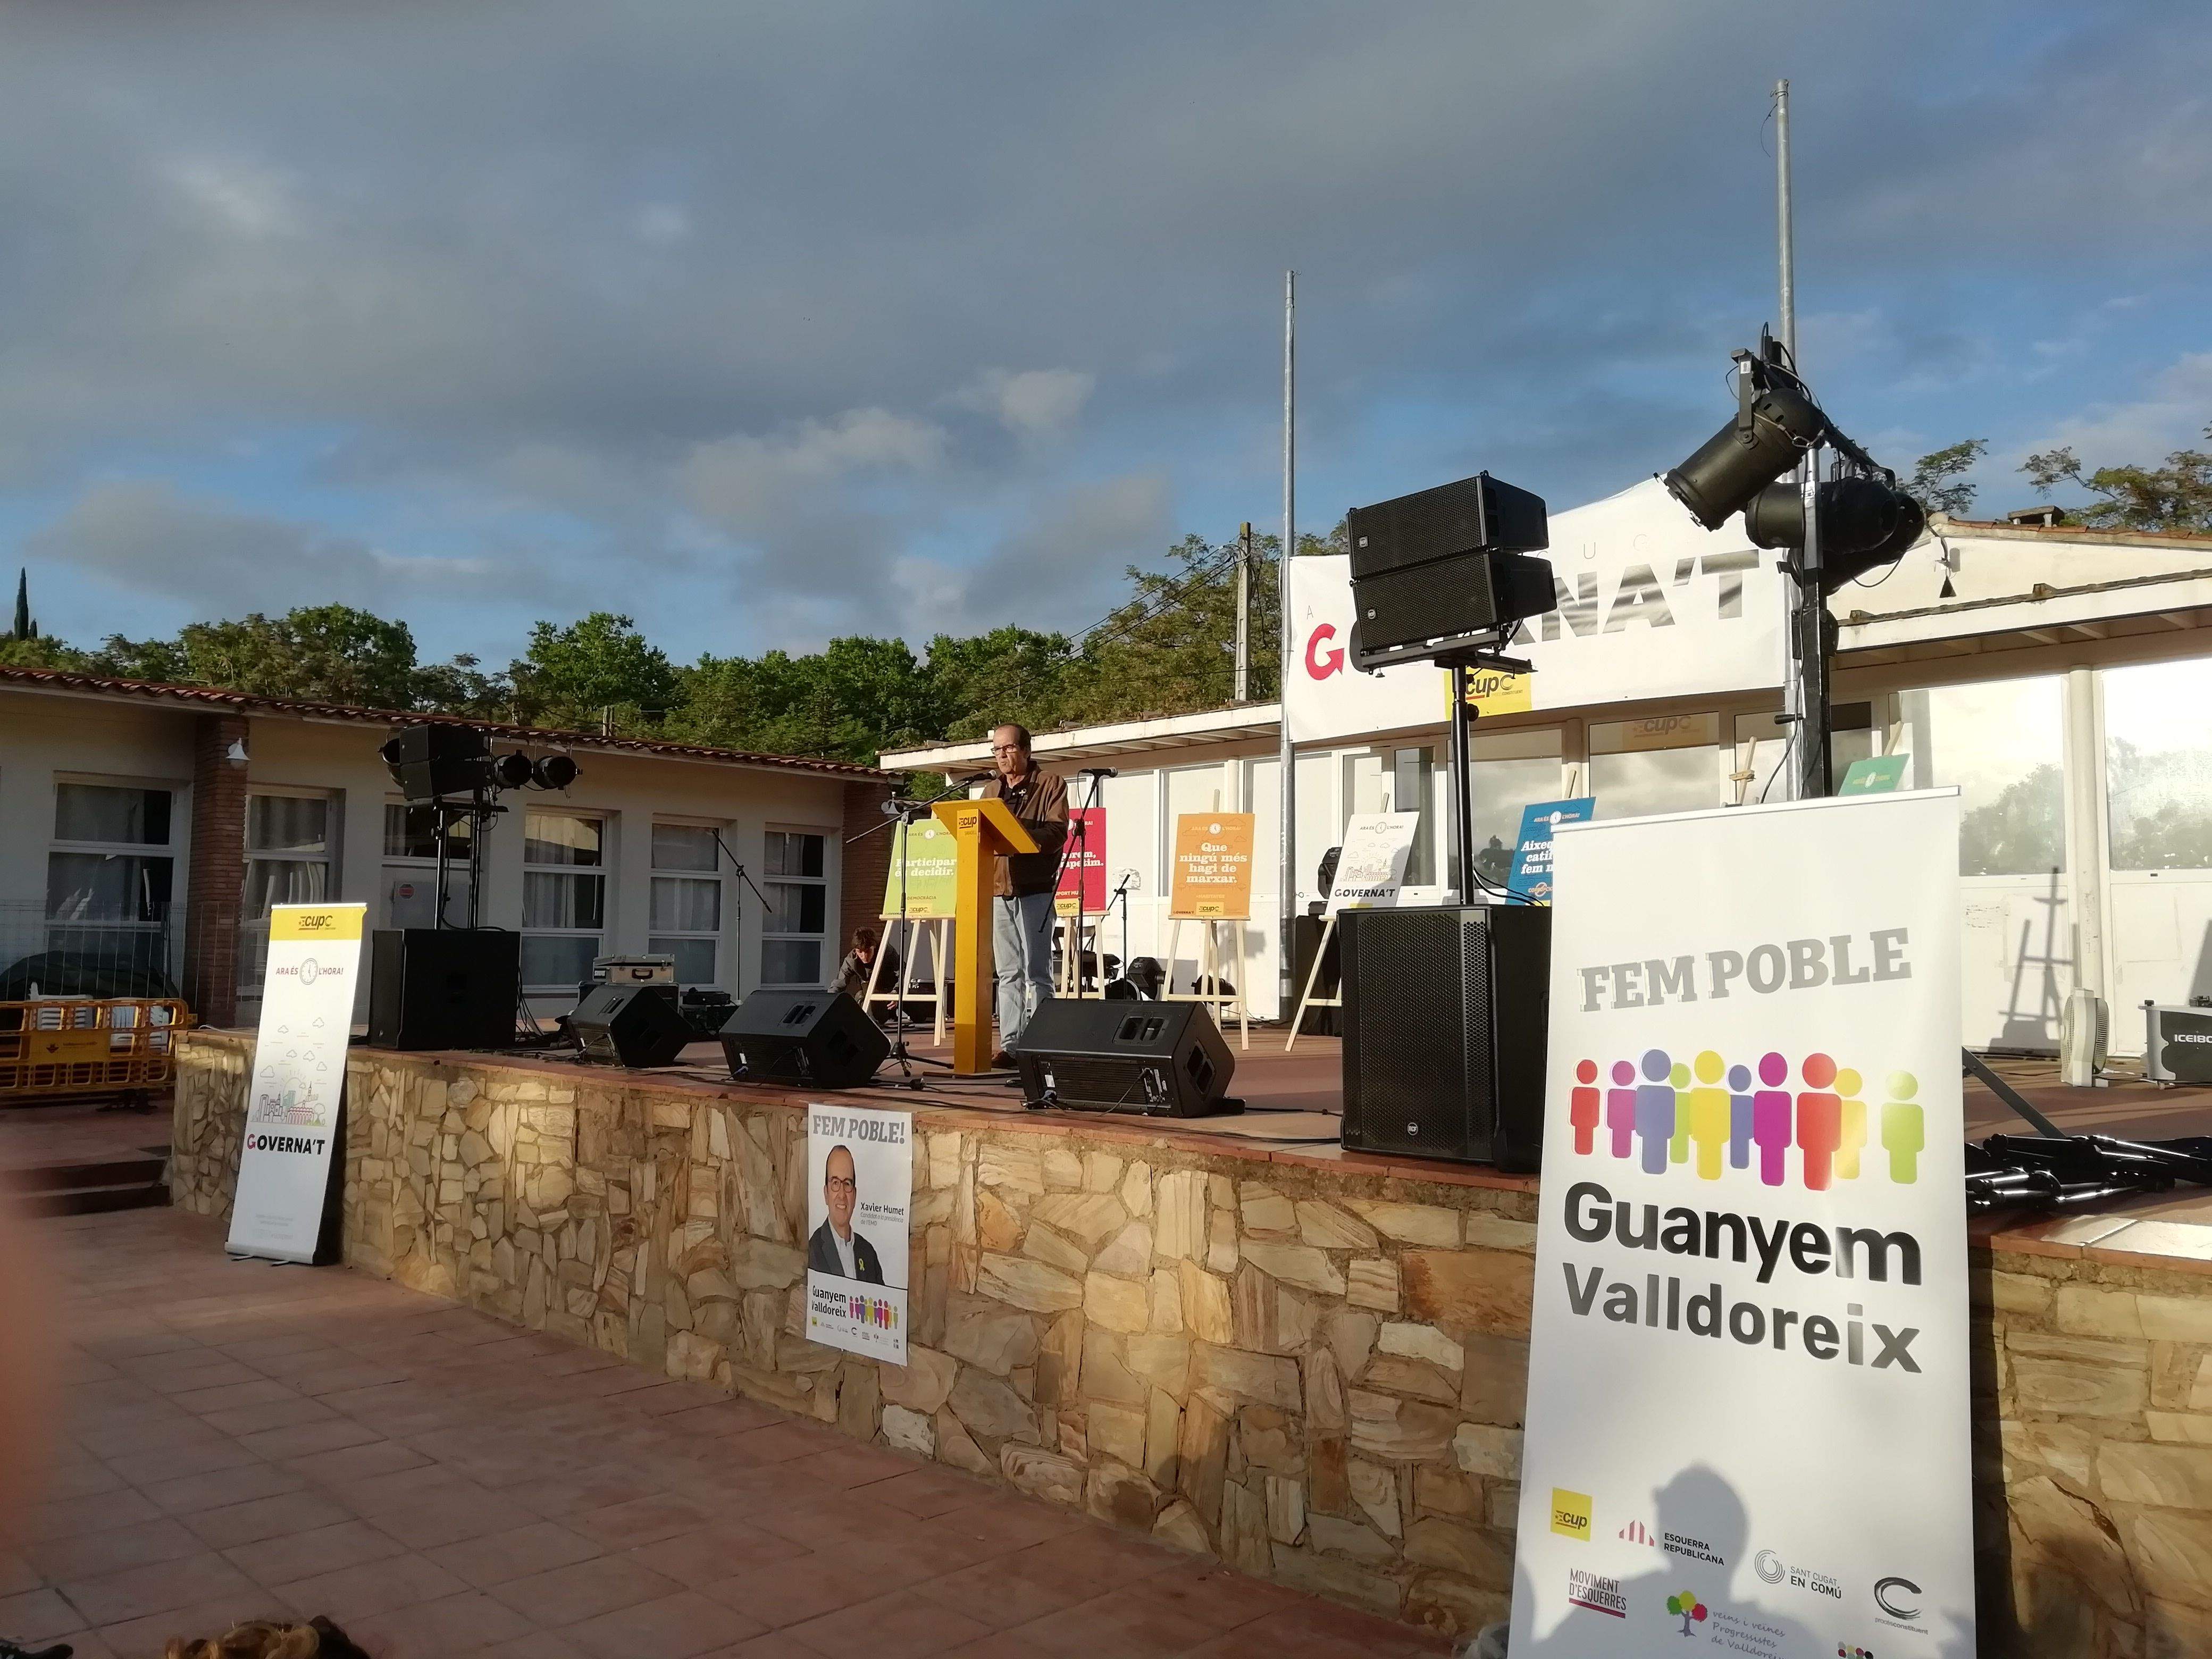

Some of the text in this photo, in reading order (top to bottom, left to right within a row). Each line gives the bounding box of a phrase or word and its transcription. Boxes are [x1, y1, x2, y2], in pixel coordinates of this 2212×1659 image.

[1201, 842, 1227, 852] Que
[1179, 852, 1247, 864] ningú més
[911, 868, 954, 877] decidir.
[1189, 864, 1237, 874] hagi de
[1521, 864, 1543, 874] fem
[1335, 889, 1395, 898] GOVERNA'T
[290, 966, 298, 975] ÉS
[1576, 927, 1913, 1012] FEM POBLE
[813, 1115, 905, 1144] FEM POBLE!
[247, 1134, 325, 1155] GOVERNA'T
[860, 1202, 904, 1216] Xavier Humet
[1564, 1182, 1923, 1286] Guanyem
[812, 1285, 846, 1303] Guanyem
[811, 1300, 847, 1318] Valldoreix
[1562, 1262, 1923, 1374] Valldoreix
[1664, 1532, 1710, 1552] ESQUERRA
[1664, 1543, 1725, 1566] REPUBLICANA
[1570, 1568, 1620, 1594] MOVIMENT
[1790, 1566, 1838, 1586] SANT CUGAT
[1569, 1582, 1627, 1611] D'ESQUERRES
[1790, 1576, 1842, 1599] EN COMÚ
[1713, 1622, 1778, 1648] Progressistes
[1711, 1636, 1788, 1659] de Valldorei
